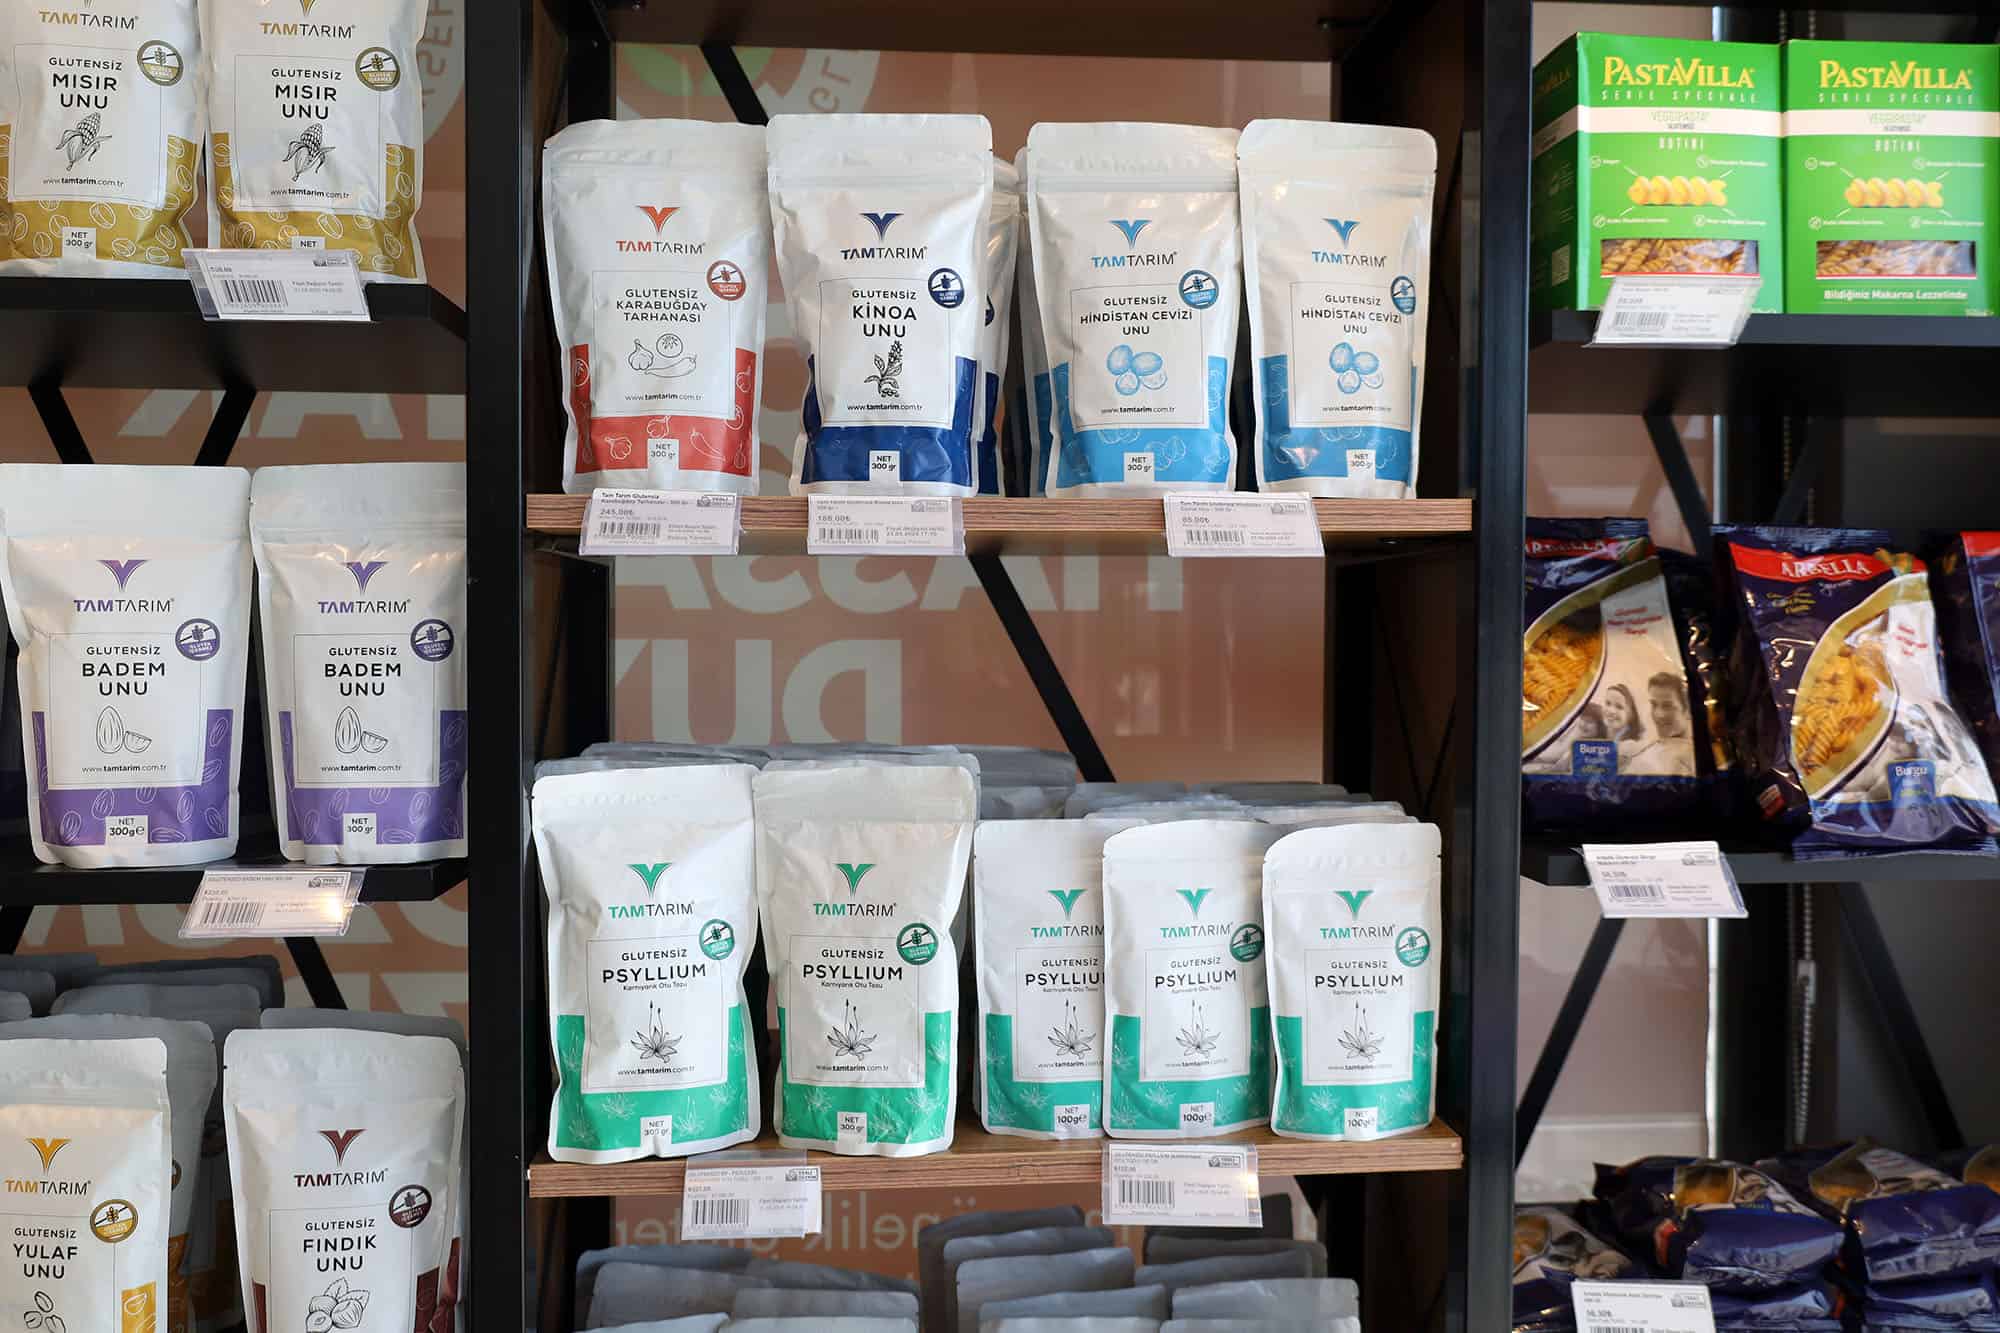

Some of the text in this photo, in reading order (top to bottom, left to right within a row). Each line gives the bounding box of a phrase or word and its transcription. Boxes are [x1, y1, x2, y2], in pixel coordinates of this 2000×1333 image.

[39, 10, 135, 30] TAMTARIM
[260, 22, 352, 39] TAMTARIM
[48, 56, 123, 71] GLUTENSİZ
[271, 68, 342, 81] GLUTENSİZ
[52, 73, 117, 91] MISIR
[275, 84, 337, 101] MISIR
[60, 93, 108, 109] UNU
[282, 103, 329, 120] UNU
[71, 231, 88, 239] NET
[65, 239, 93, 249] 300 gr
[300, 240, 317, 249] NET
[616, 240, 703, 254] TAMTARIM
[840, 247, 925, 260] TAMTARIM
[1312, 251, 1385, 268] TAMTARIM
[1092, 253, 1175, 268] TAMTARIM
[625, 287, 699, 299] GLUTENSİZ
[852, 288, 917, 300] GLUTENSİZ
[616, 298, 708, 313] KARABUĞDAY
[1103, 294, 1168, 306] GLUTENSİZ
[1325, 294, 1381, 306] GLUTENSİZ
[852, 301, 917, 321] KİNOA
[1080, 309, 1193, 325] HİNDİSTAN CEVİZİ
[1301, 308, 1366, 322] HİNDİSTAN
[624, 313, 702, 324] TARHANASI
[863, 322, 907, 338] UNU
[1123, 325, 1150, 336] UNU
[1343, 323, 1368, 335] UNU
[655, 443, 672, 451] NET
[650, 451, 677, 460] 300 gr
[876, 455, 893, 463] NET
[1353, 452, 1369, 460] NET
[872, 463, 897, 472] 300 gr
[1128, 463, 1152, 473] 300 gr
[1350, 459, 1365, 468] 300
[74, 599, 171, 613] TAMTARIM
[318, 600, 408, 613] TAMTARIM
[87, 644, 161, 656] GLUTENSİZ
[329, 645, 397, 656] GLUTENSİZ
[82, 662, 166, 677] BADEM
[325, 663, 402, 677] BADEM
[99, 681, 148, 696] UNU
[340, 682, 385, 696] UNU
[118, 818, 135, 826] NET
[352, 818, 368, 826] NET
[347, 825, 374, 836] 300 gr
[609, 903, 694, 919] TAMTARIM
[814, 902, 894, 917] TAMTARIM
[1161, 926, 1231, 939] TAMTARIM
[1320, 926, 1394, 939] TAMTARIM
[622, 948, 688, 961] GLUTENSİZ
[821, 949, 884, 960] GLUTENSİZ
[1041, 959, 1099, 968] GLUTENSİZ
[1170, 956, 1221, 969] GLUTENSİZ
[1331, 960, 1388, 969] GLUTENSİZ
[602, 963, 706, 984] PSYLLIUM
[803, 964, 903, 981] PSYLLIUM
[1155, 970, 1237, 988] PSYLLIUM
[1314, 973, 1404, 988] PSYLLIUM
[1065, 1107, 1079, 1115] NET
[1190, 1105, 1204, 1113] NET
[648, 1120, 665, 1128] NET
[840, 1124, 855, 1132] 300
[644, 1128, 670, 1138] 300 gr
[294, 1170, 386, 1188] TAMTARIM
[5, 1179, 89, 1195] TAMTARIM
[305, 1218, 376, 1232] GLUTENSİZ
[14, 1226, 77, 1240] GLUTENSİZ
[303, 1234, 377, 1252] FINDIK
[14, 1243, 78, 1261] YULAF
[23, 1263, 65, 1279] UNU
[316, 1256, 364, 1273] UNU
